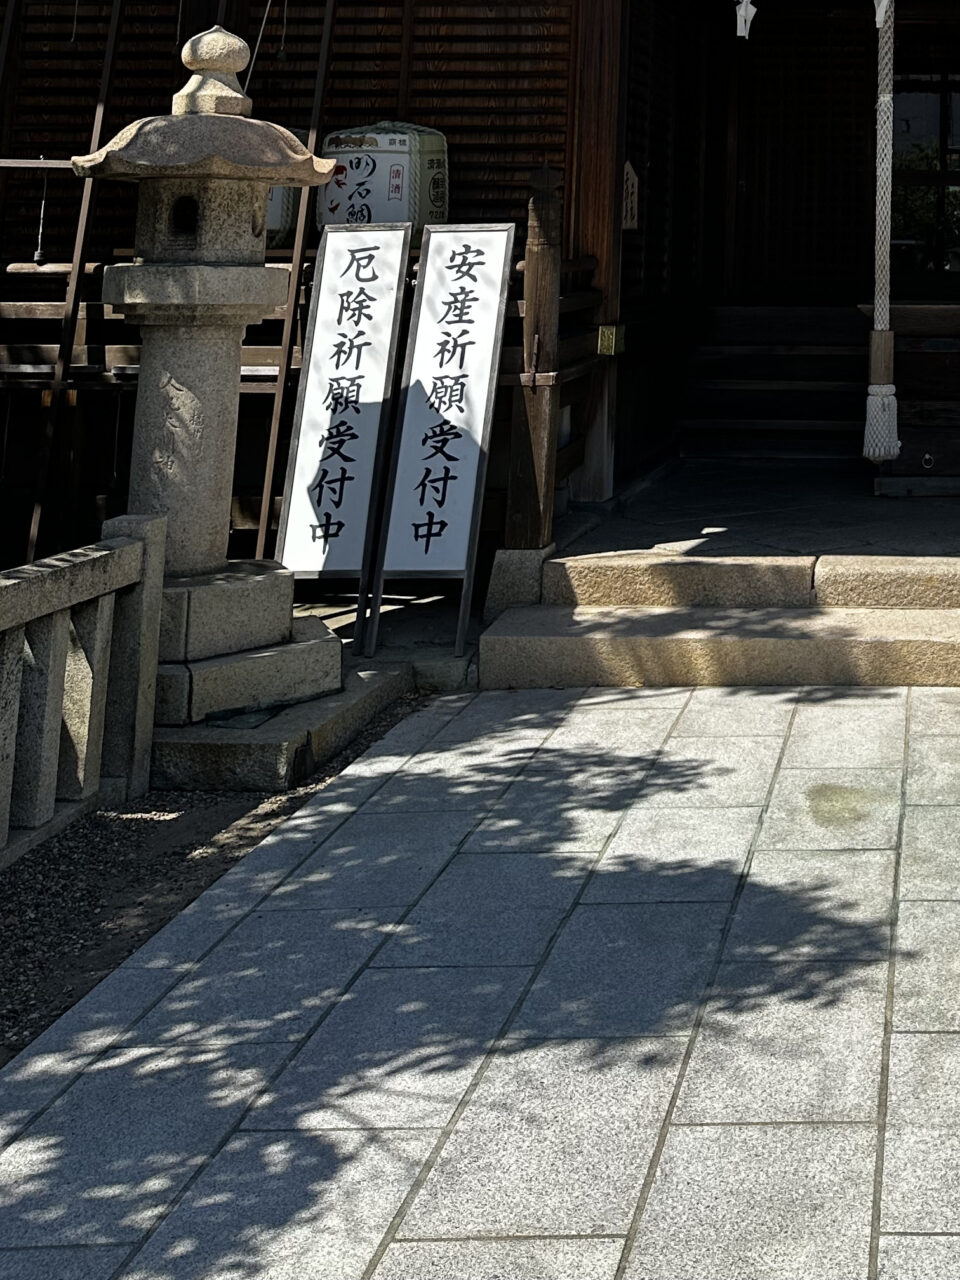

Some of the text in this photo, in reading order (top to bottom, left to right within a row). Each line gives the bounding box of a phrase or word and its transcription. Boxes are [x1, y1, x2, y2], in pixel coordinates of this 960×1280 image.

[309, 244, 382, 555] 厄除祈願受付中
[411, 243, 486, 555] 安産祈願受付中
